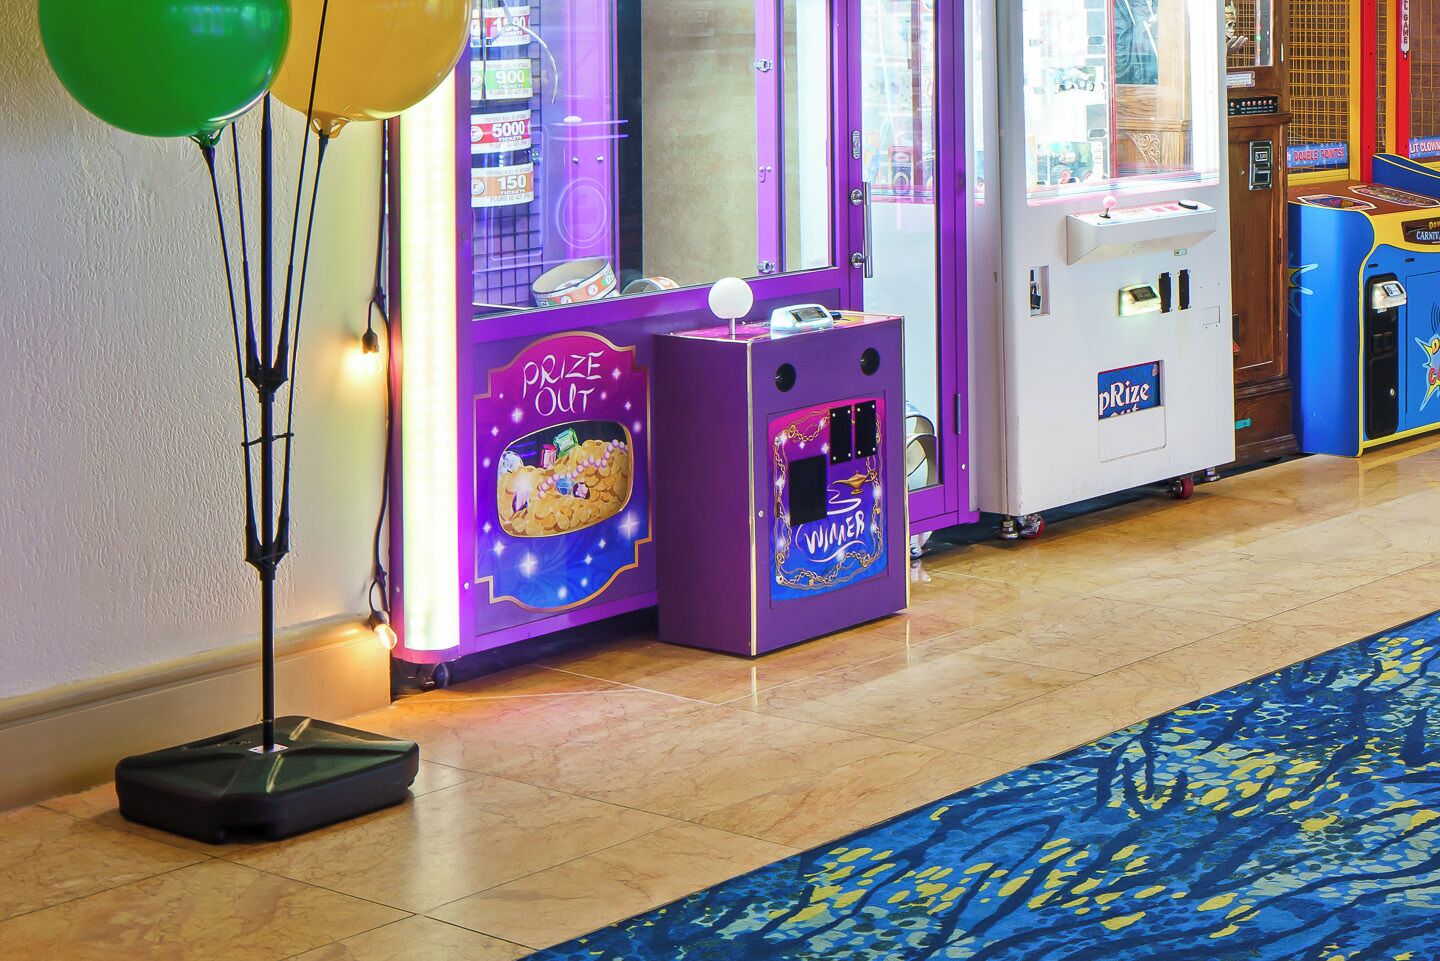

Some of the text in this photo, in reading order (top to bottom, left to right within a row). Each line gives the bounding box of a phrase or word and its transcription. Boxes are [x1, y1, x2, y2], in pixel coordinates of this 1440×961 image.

[495, 70, 525, 84] 900
[491, 120, 526, 138] 5000
[1293, 147, 1319, 161] DOUBLE
[1320, 146, 1344, 160] POINTS!
[497, 175, 527, 190] 150
[522, 350, 605, 401] PRIZE
[535, 382, 596, 417] OUT
[803, 510, 866, 555] WINNER
